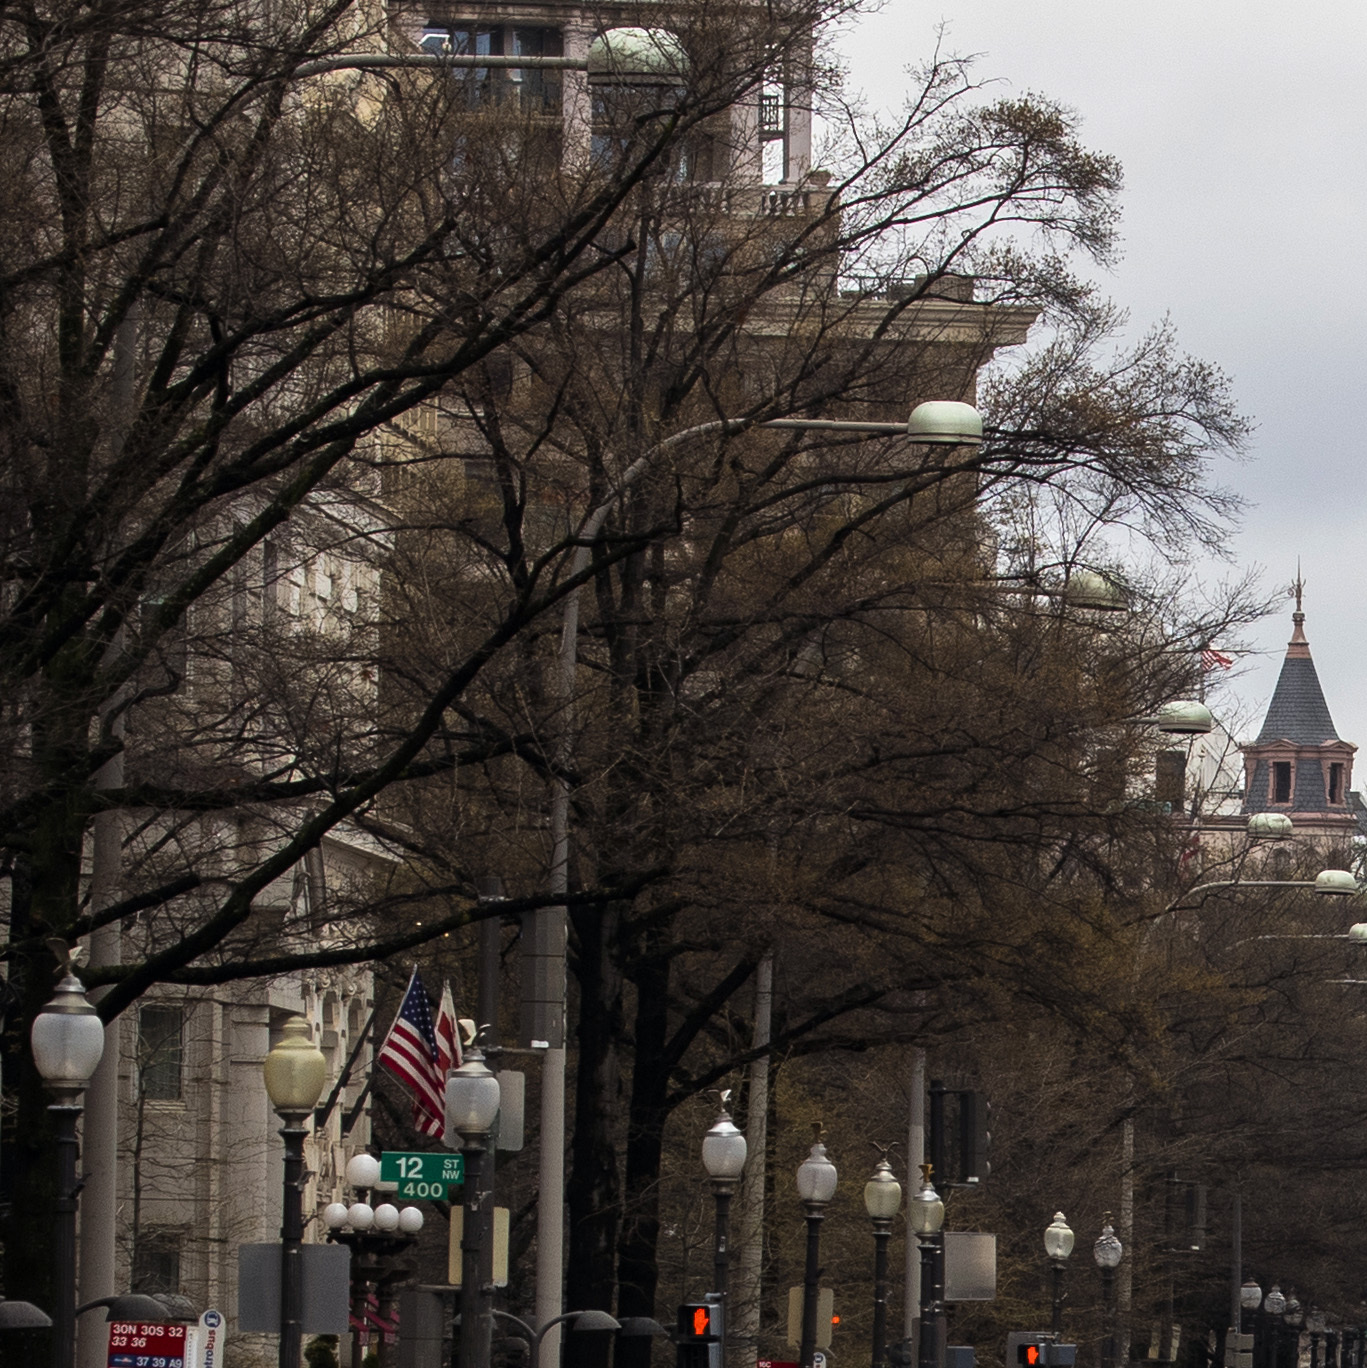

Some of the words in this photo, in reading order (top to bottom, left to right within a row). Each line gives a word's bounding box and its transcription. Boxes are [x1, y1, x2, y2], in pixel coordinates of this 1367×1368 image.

[395, 1157, 423, 1179] 12
[443, 1159, 459, 1169] ST
[442, 1170, 460, 1180] NW
[403, 1182, 443, 1198] 400
[112, 1323, 137, 1335] 30N
[140, 1325, 165, 1336] 30S
[168, 1326, 184, 1338] 32
[111, 1336, 127, 1347] 33
[130, 1336, 147, 1348] 36
[136, 1356, 150, 1367] 37
[152, 1357, 166, 1368] 39
[168, 1358, 183, 1368] A9
